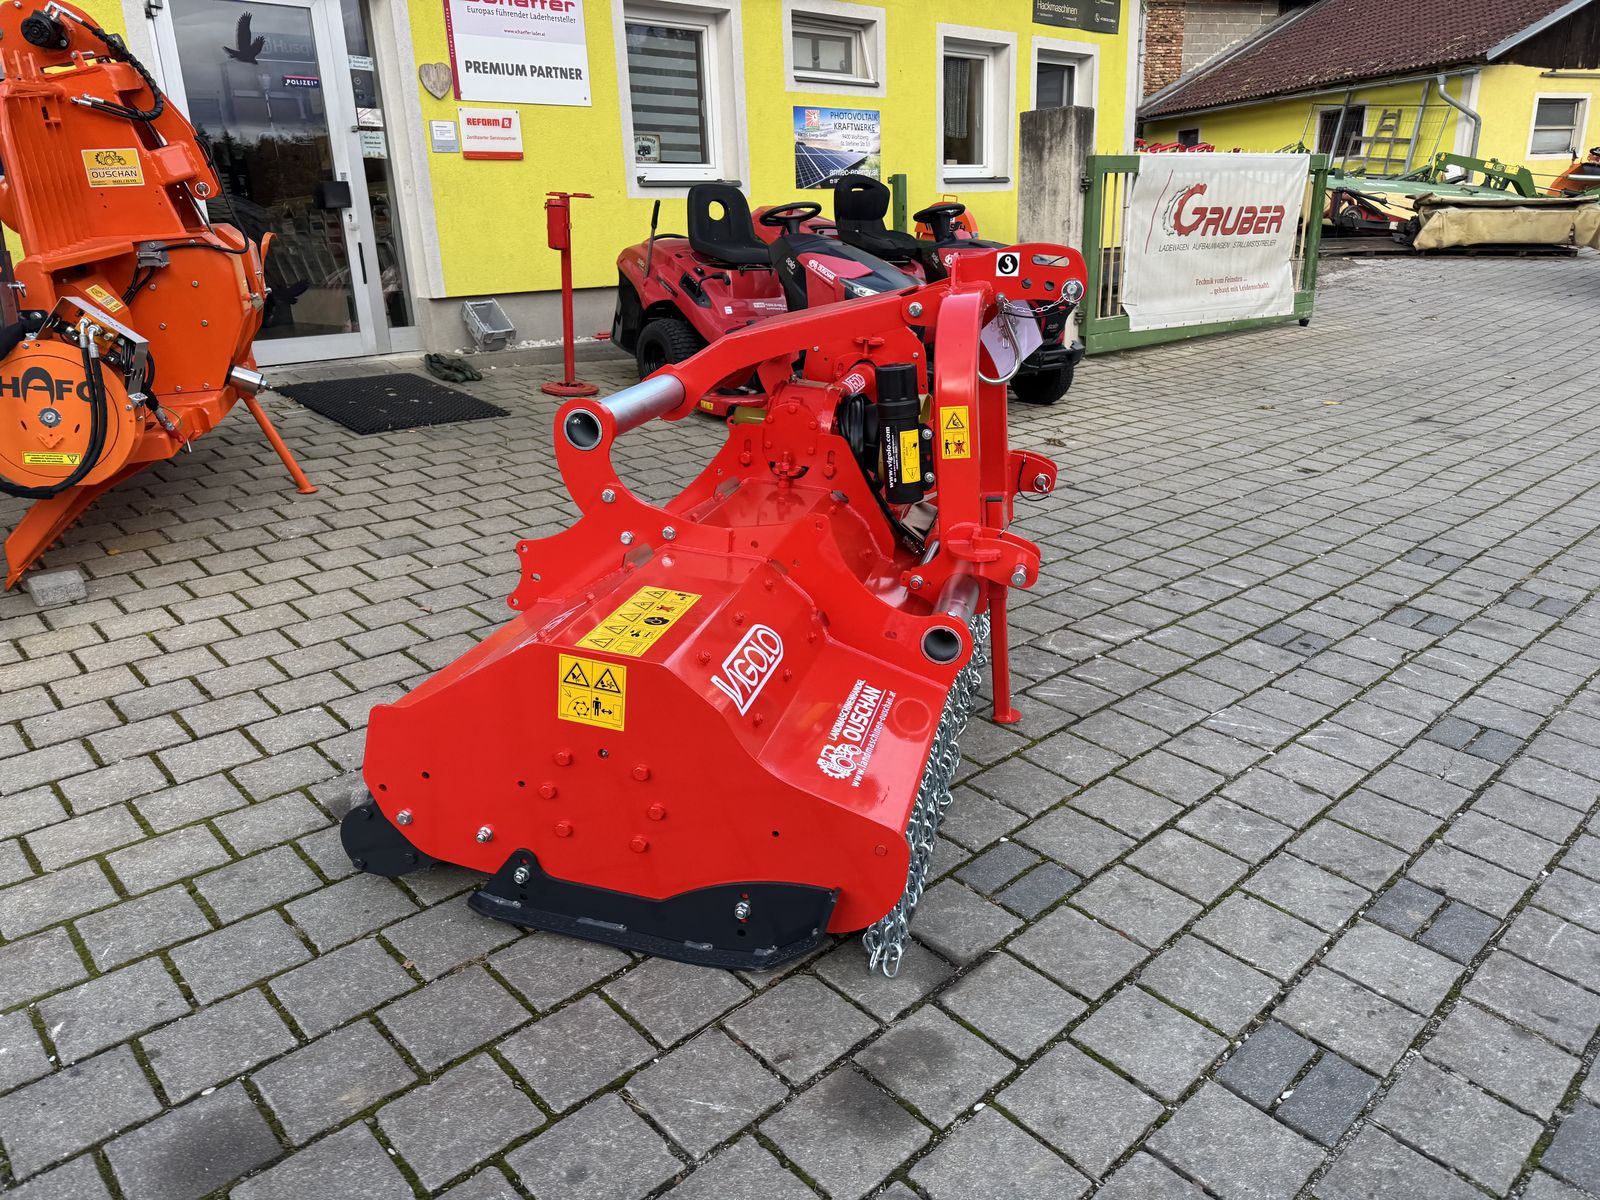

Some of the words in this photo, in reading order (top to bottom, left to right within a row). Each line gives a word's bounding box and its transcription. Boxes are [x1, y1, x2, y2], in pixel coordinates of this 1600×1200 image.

[467, 5, 495, 16] Europas
[496, 7, 529, 19] führender
[530, 12, 576, 24] Laderhersteller
[1037, 0, 1078, 15] Hackmaschinen
[464, 60, 528, 77] PREMIUM
[530, 64, 583, 81] PARTNER
[466, 117, 500, 127] REFORM
[830, 111, 879, 121] PHOTOVOLTAIK
[833, 122, 875, 131] KRAFTWERKE
[91, 170, 138, 179] OUSCHAN
[1173, 183, 1286, 237] GRUBER
[1158, 242, 1190, 252] LADEWAGEN
[1192, 241, 1231, 251] AUFBAUWAGEN
[1232, 239, 1277, 249] STALLMISTSTREUER
[1195, 278, 1214, 286] Technik
[885, 426, 894, 488] www.vigolo.com
[710, 624, 784, 717] VIGOLO
[828, 679, 867, 741] LANDMASCHINENHANDEL
[842, 685, 882, 741] OUSCHAN
[851, 691, 897, 788] www.landmaschinen-ouschan.at
